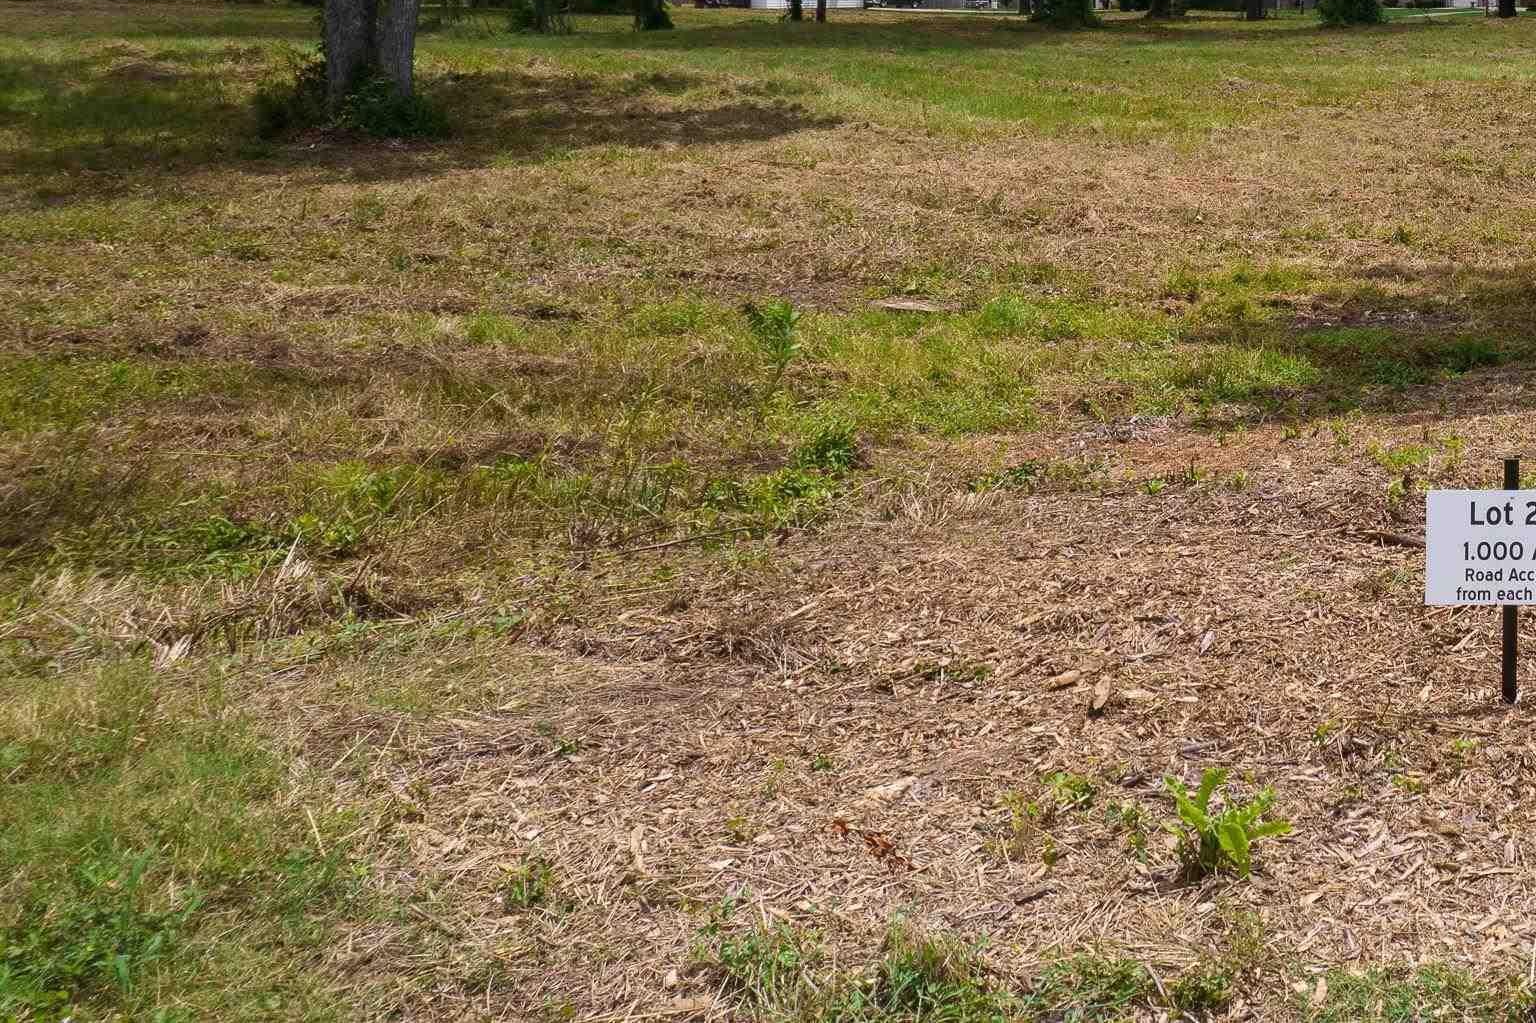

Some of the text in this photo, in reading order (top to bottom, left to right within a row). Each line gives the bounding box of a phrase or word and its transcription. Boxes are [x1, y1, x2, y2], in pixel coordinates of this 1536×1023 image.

[1470, 501, 1514, 526] Lot
[1463, 541, 1524, 561] 1.000
[1465, 568, 1503, 582] Road
[1456, 587, 1491, 601] from
[1497, 587, 1533, 601] each
